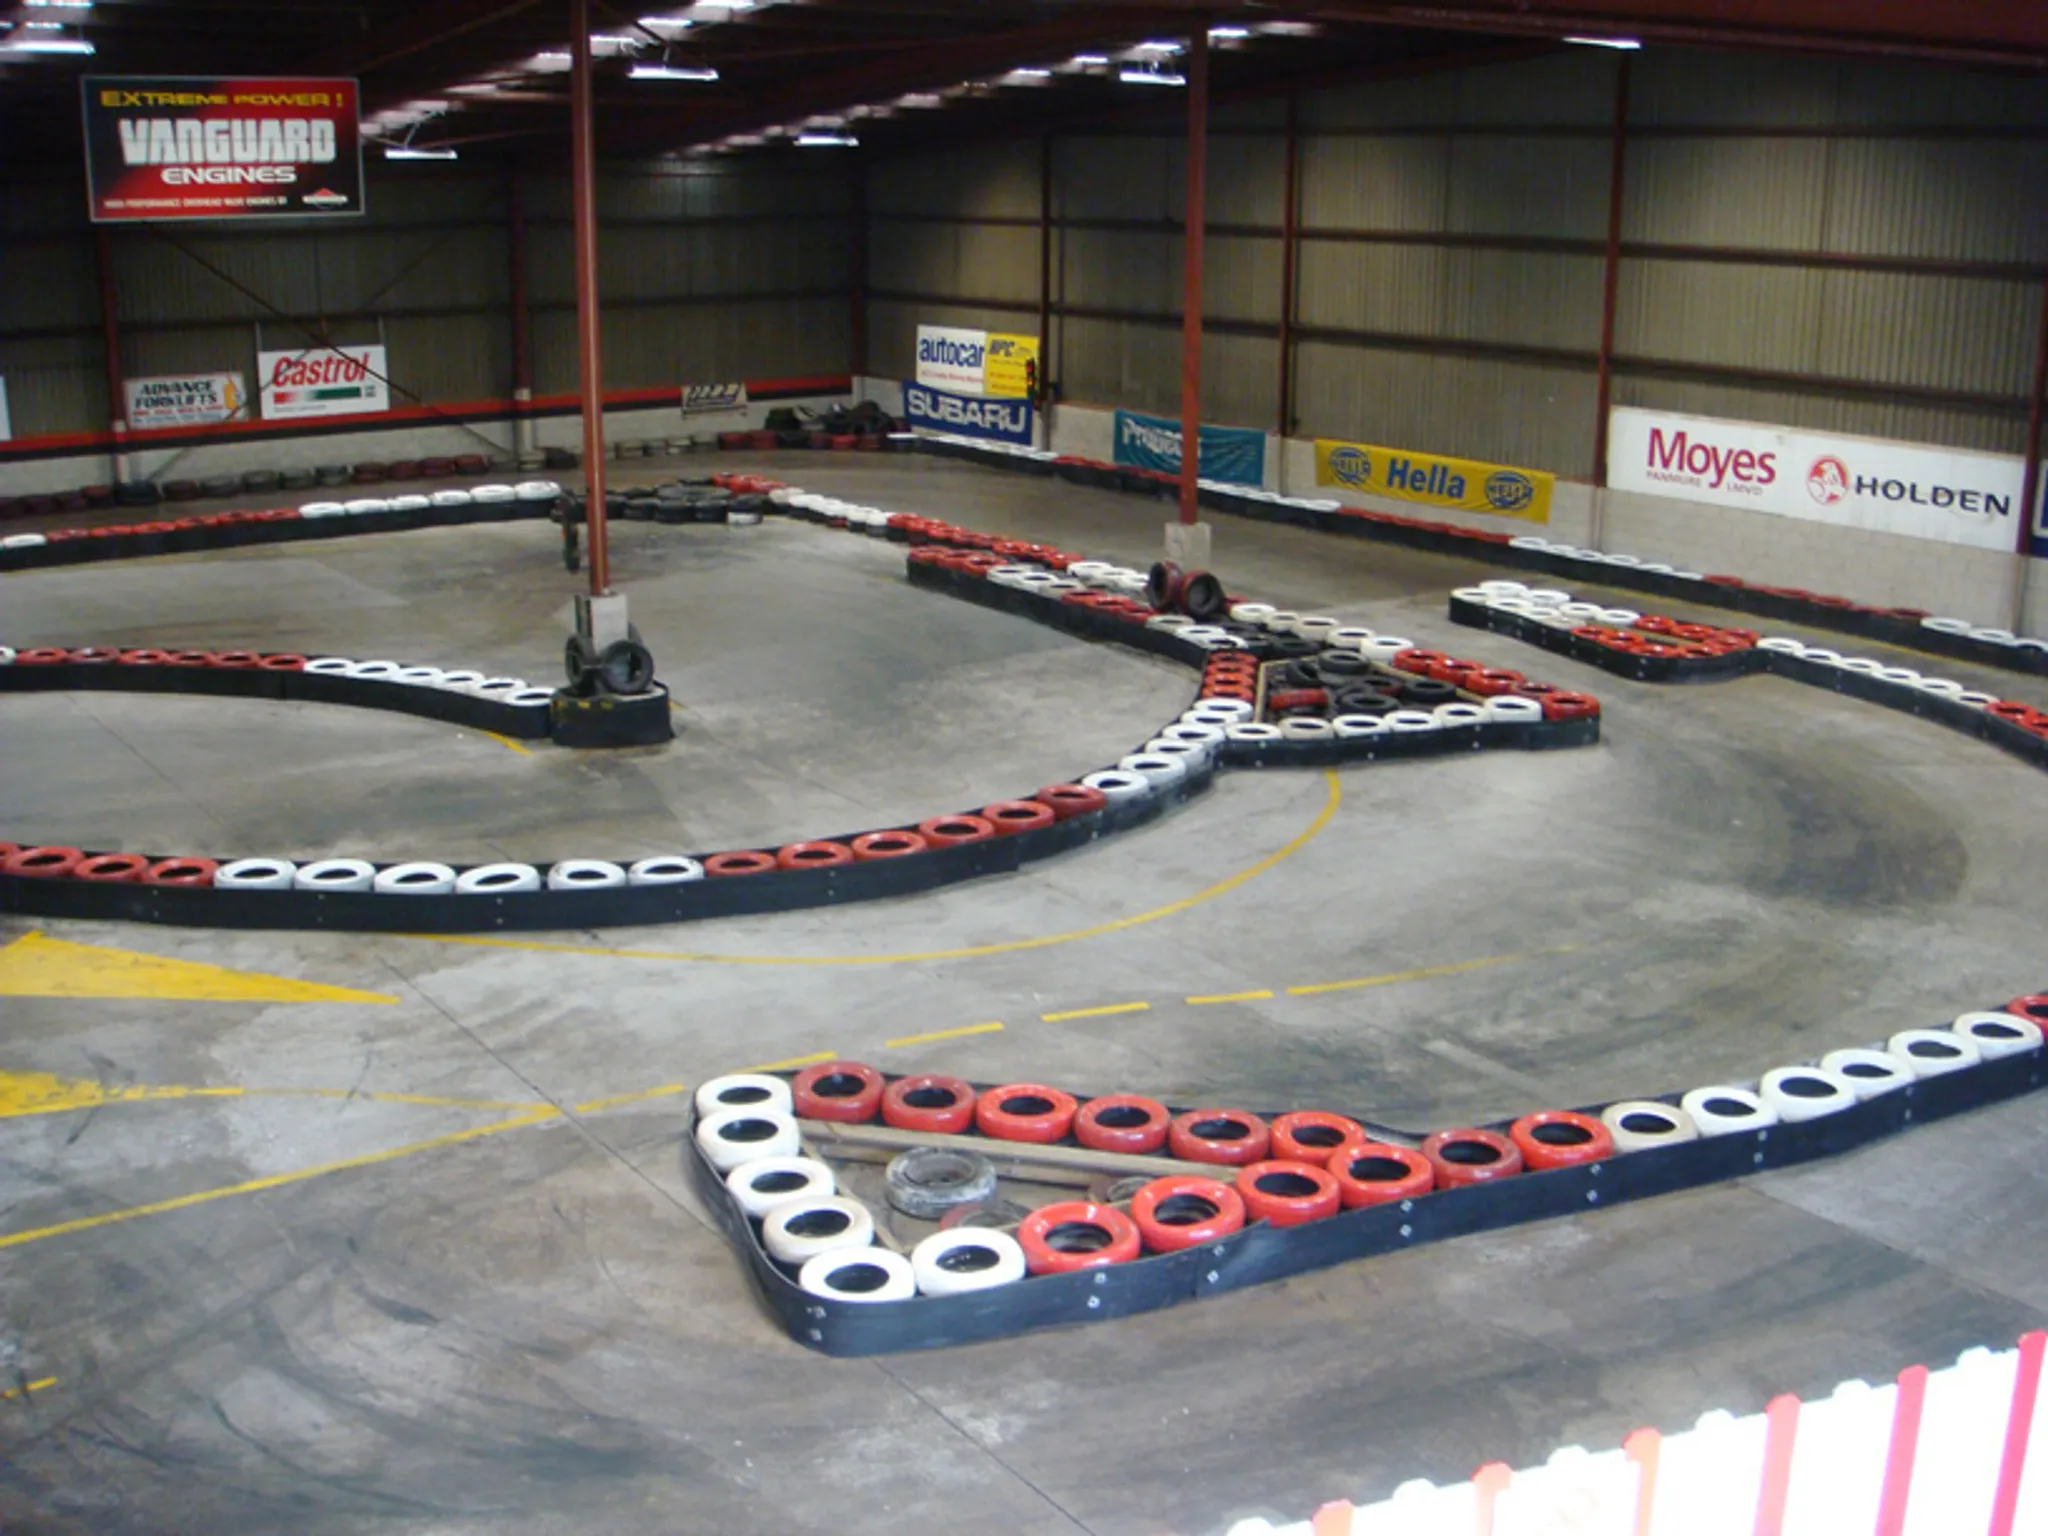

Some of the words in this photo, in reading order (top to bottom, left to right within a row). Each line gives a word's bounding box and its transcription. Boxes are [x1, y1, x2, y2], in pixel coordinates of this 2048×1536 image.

[101, 90, 228, 108] EXTREME
[233, 92, 330, 106] POWER
[118, 118, 337, 165] VANGUARD
[160, 165, 297, 185] ENGINES
[272, 351, 371, 387] Castrol
[918, 336, 985, 368] autocar
[140, 379, 215, 395] ADVANCE
[907, 388, 1026, 433] SUBARU
[1646, 426, 1778, 489] Moyes
[1385, 457, 1466, 500] Hella
[1854, 473, 2011, 517] HOLDEN
